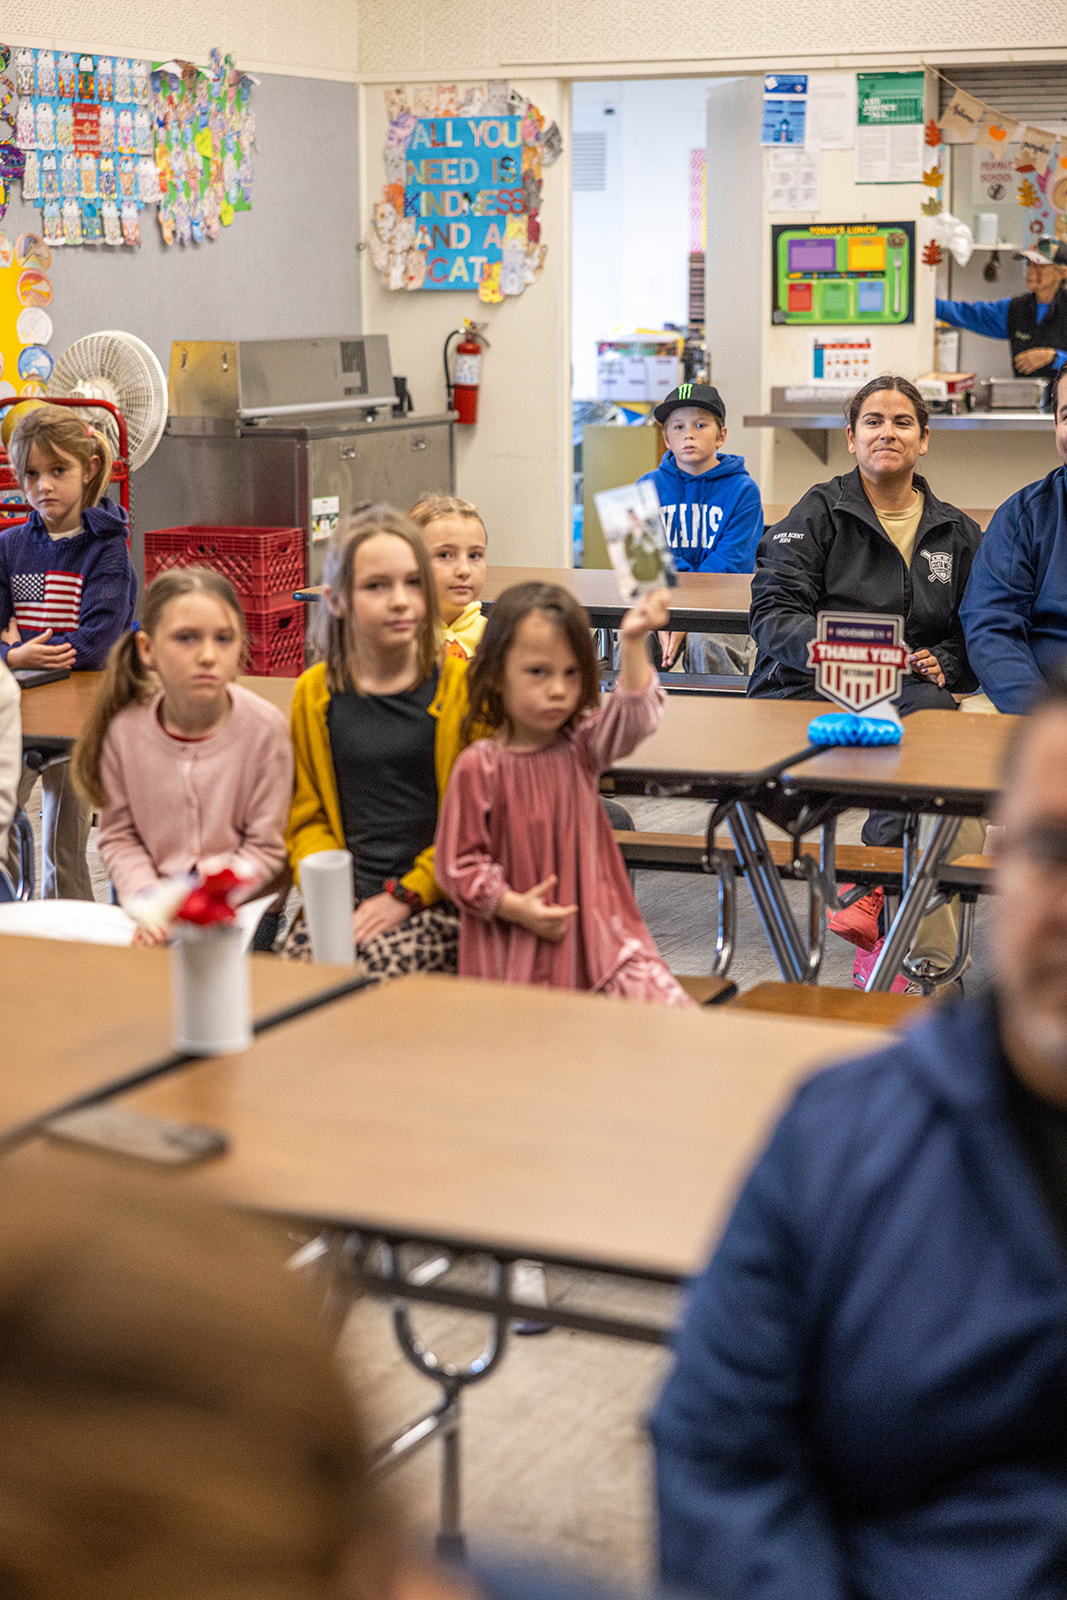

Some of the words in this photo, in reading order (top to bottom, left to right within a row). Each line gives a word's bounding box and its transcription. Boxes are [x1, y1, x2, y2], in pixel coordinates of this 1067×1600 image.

[412, 121, 463, 149] ALL
[468, 120, 522, 148] YOU
[406, 158, 480, 185] NEED
[492, 156, 517, 183] IS
[403, 189, 527, 218] KINDNESS
[416, 223, 472, 250] AND
[483, 223, 504, 249] A
[847, 224, 879, 235] LUNCH
[428, 256, 488, 283] CAT
[659, 503, 724, 549] VANS
[817, 644, 869, 662] THANK
[869, 648, 903, 664] YOU
